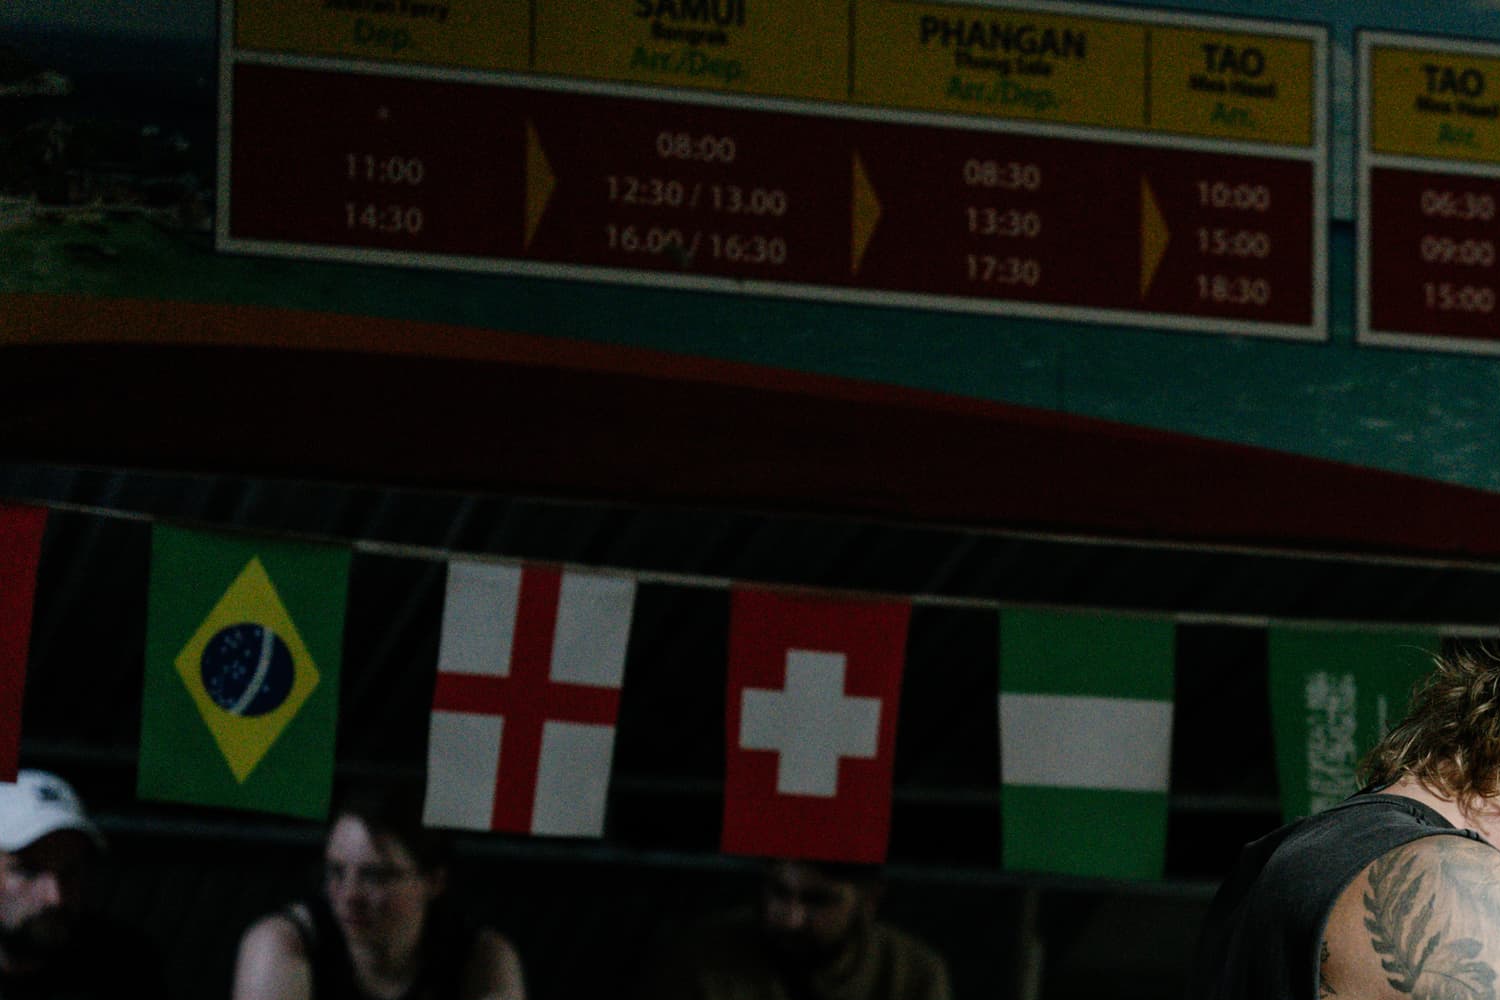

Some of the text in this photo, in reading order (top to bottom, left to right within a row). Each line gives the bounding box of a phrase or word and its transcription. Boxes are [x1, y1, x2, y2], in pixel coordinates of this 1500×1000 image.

[920, 15, 1087, 59] PHANGAN
[1203, 43, 1264, 77] TAO
[1423, 64, 1485, 97] TAO
[655, 132, 736, 163] 08:00
[344, 152, 425, 186] 11:00
[962, 158, 1041, 191] 08:30
[606, 176, 684, 208] 12:30
[1196, 180, 1271, 212] 10:00
[344, 201, 424, 234] 14:30
[966, 206, 1041, 239] 13:30
[710, 232, 788, 264] 16:30
[1196, 227, 1271, 259] 15:00
[966, 254, 1041, 287] 17:30
[1196, 274, 1271, 306] 18:30
[1423, 281, 1496, 313] 15:00
